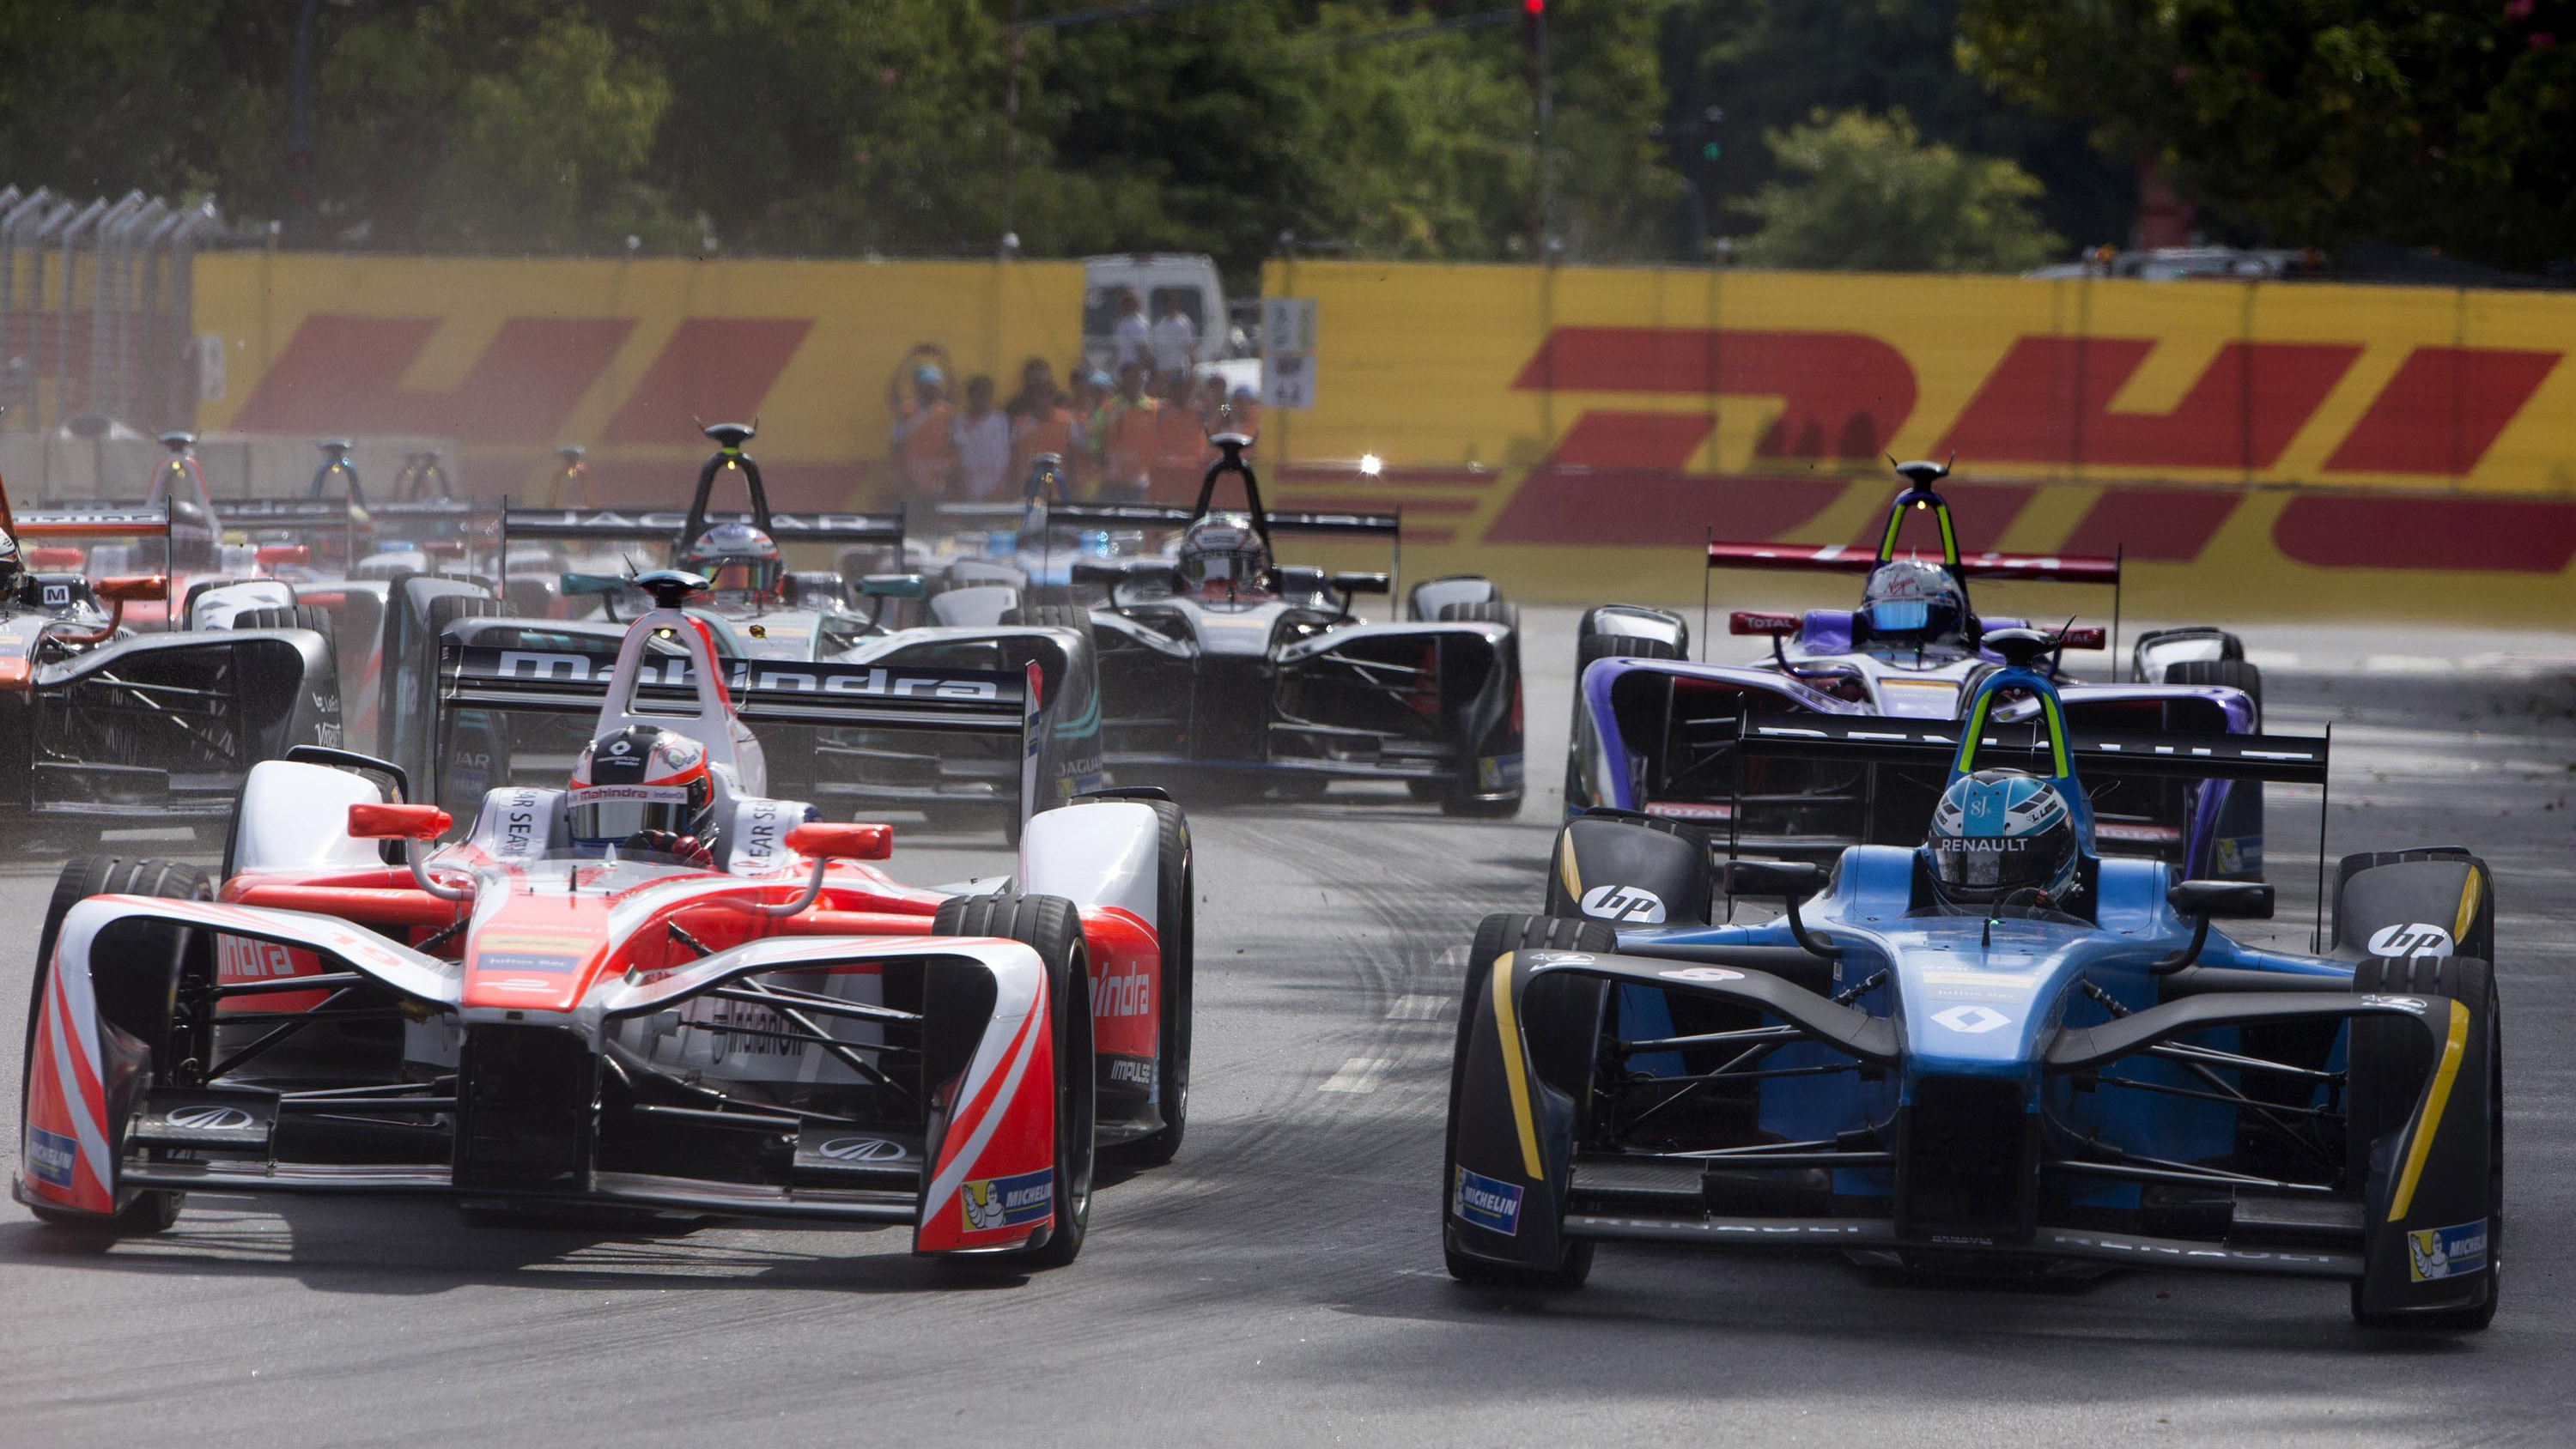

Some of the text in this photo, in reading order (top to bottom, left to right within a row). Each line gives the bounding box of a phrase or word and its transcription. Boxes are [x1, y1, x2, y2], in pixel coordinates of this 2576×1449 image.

[1485, 327, 2576, 572] DHL
[1888, 573, 1917, 594] Virgin
[46, 589, 65, 601] M
[1745, 617, 1793, 628] TOTAL
[580, 787, 648, 801] Mahindra
[1941, 838, 2029, 852] RENAULT
[1591, 885, 1658, 921] hp
[2379, 925, 2445, 957] hp
[1110, 1060, 1151, 1083] IMPULSE
[1464, 1185, 1519, 1216] MICHELIN
